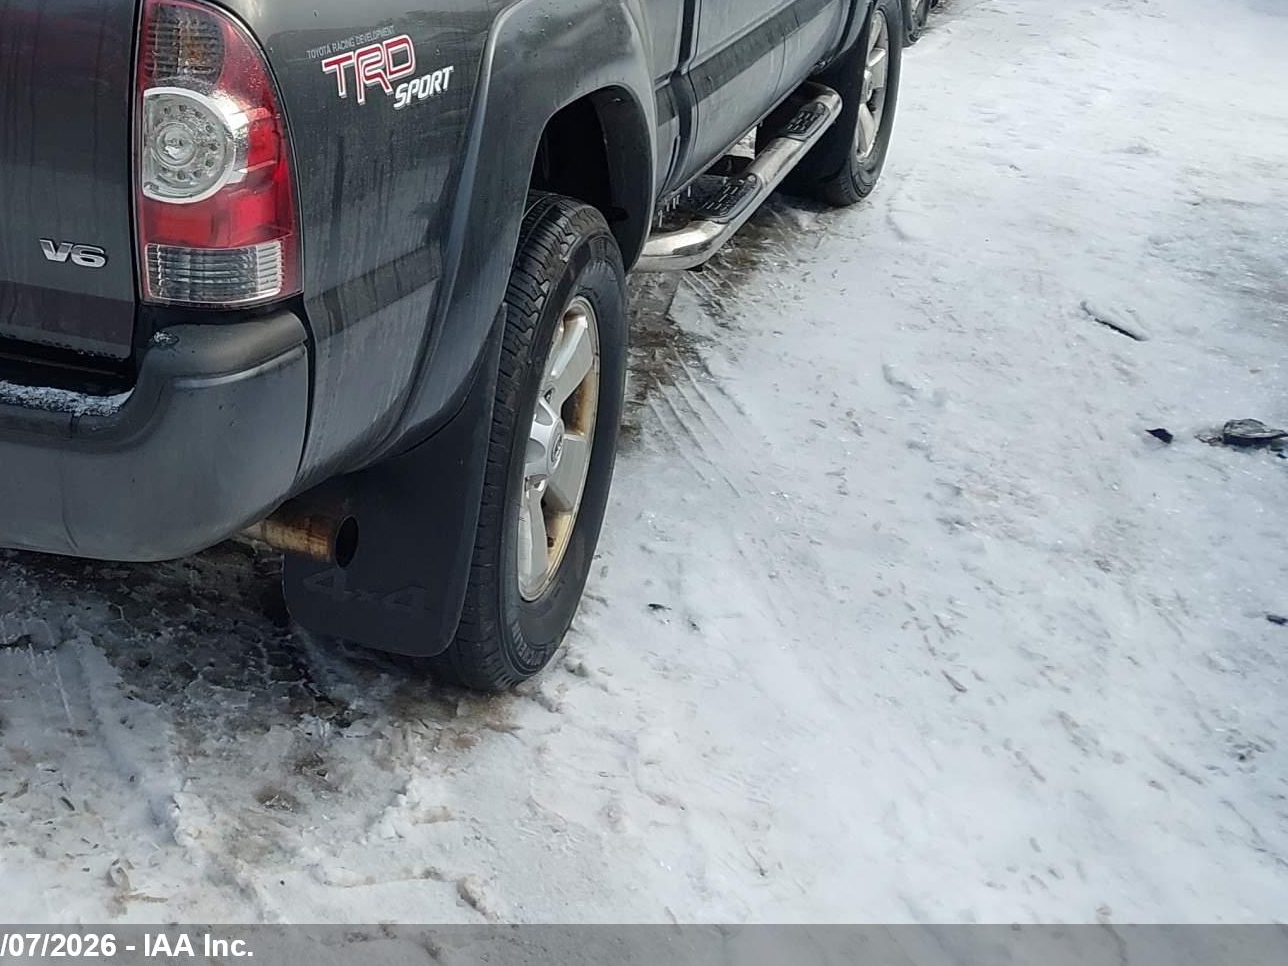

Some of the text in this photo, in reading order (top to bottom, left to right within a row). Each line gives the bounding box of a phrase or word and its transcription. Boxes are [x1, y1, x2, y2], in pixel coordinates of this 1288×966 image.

[306, 44, 331, 59] TOYOTA
[332, 36, 355, 53] RACING
[322, 34, 416, 105] TRD
[393, 66, 455, 110] SPORT
[39, 239, 106, 268] V6
